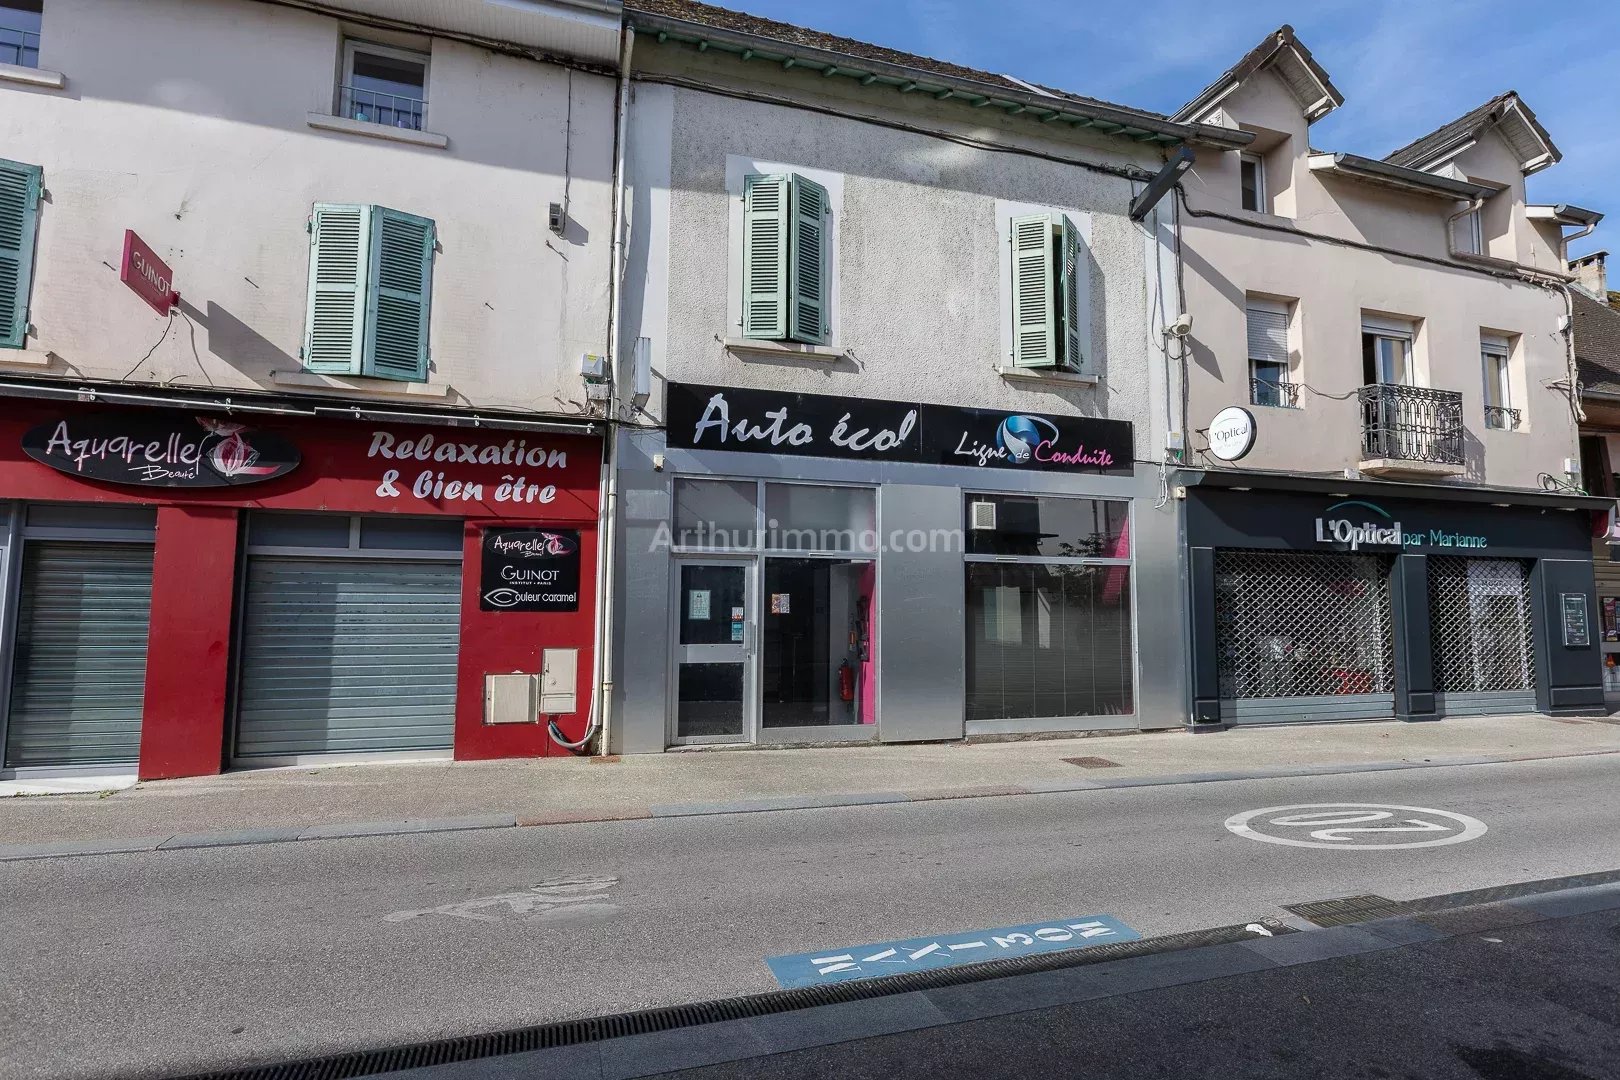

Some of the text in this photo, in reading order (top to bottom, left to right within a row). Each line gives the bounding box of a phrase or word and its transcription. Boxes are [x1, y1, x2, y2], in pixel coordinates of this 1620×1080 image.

[133, 251, 171, 297] GUINOT
[693, 392, 814, 447] Auto
[46, 420, 202, 476] Aquarelle
[367, 431, 567, 469] Relaxation
[954, 430, 1115, 467] Ligne de Conduite
[128, 465, 196, 481] Beauté
[376, 469, 557, 504] & bien être
[493, 535, 545, 555] Aquarelle
[1315, 517, 1488, 551] L'Optical par Marianne
[501, 565, 560, 581] GUINOT
[542, 592, 577, 603] caramel
